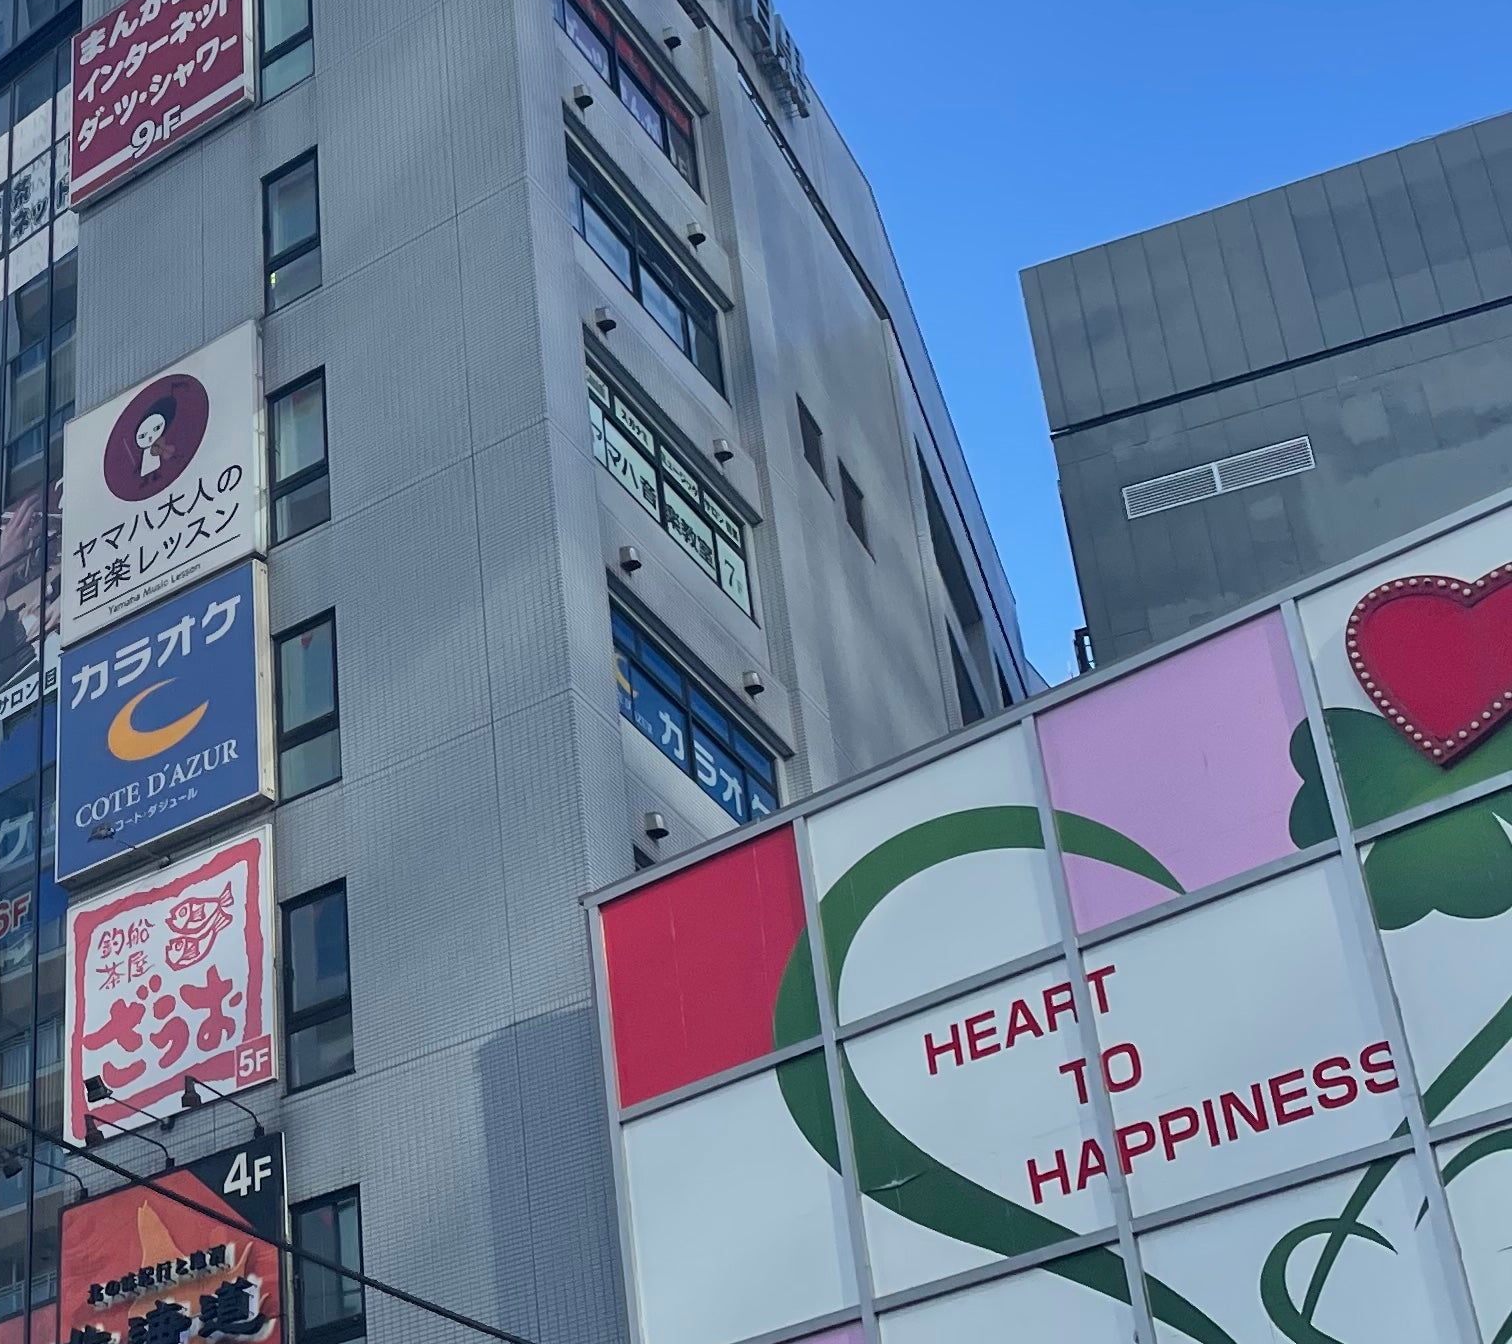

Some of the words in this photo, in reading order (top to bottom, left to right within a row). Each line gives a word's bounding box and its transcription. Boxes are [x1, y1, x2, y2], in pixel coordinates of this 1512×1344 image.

[78, 34, 238, 152] ダーツ・シャワー
[131, 106, 182, 159] 9F
[73, 464, 243, 568] ヤマハ大人の
[76, 502, 240, 606] 音楽レッスン
[108, 594, 141, 615] Yamaha
[143, 578, 169, 598] Music
[171, 563, 201, 584] Lesson
[72, 595, 241, 709] カラオケ
[75, 782, 140, 828] COTE
[148, 739, 239, 797] D'AZUR
[96, 951, 156, 991] 茶屋
[98, 918, 156, 959] 釣船
[83, 964, 244, 1089] ざうお
[238, 1047, 271, 1078] 5F
[924, 965, 1117, 1077] HEART
[1060, 1042, 1144, 1105] TO
[1026, 1040, 1400, 1205] HAPPINESS
[224, 1152, 273, 1198] 4F
